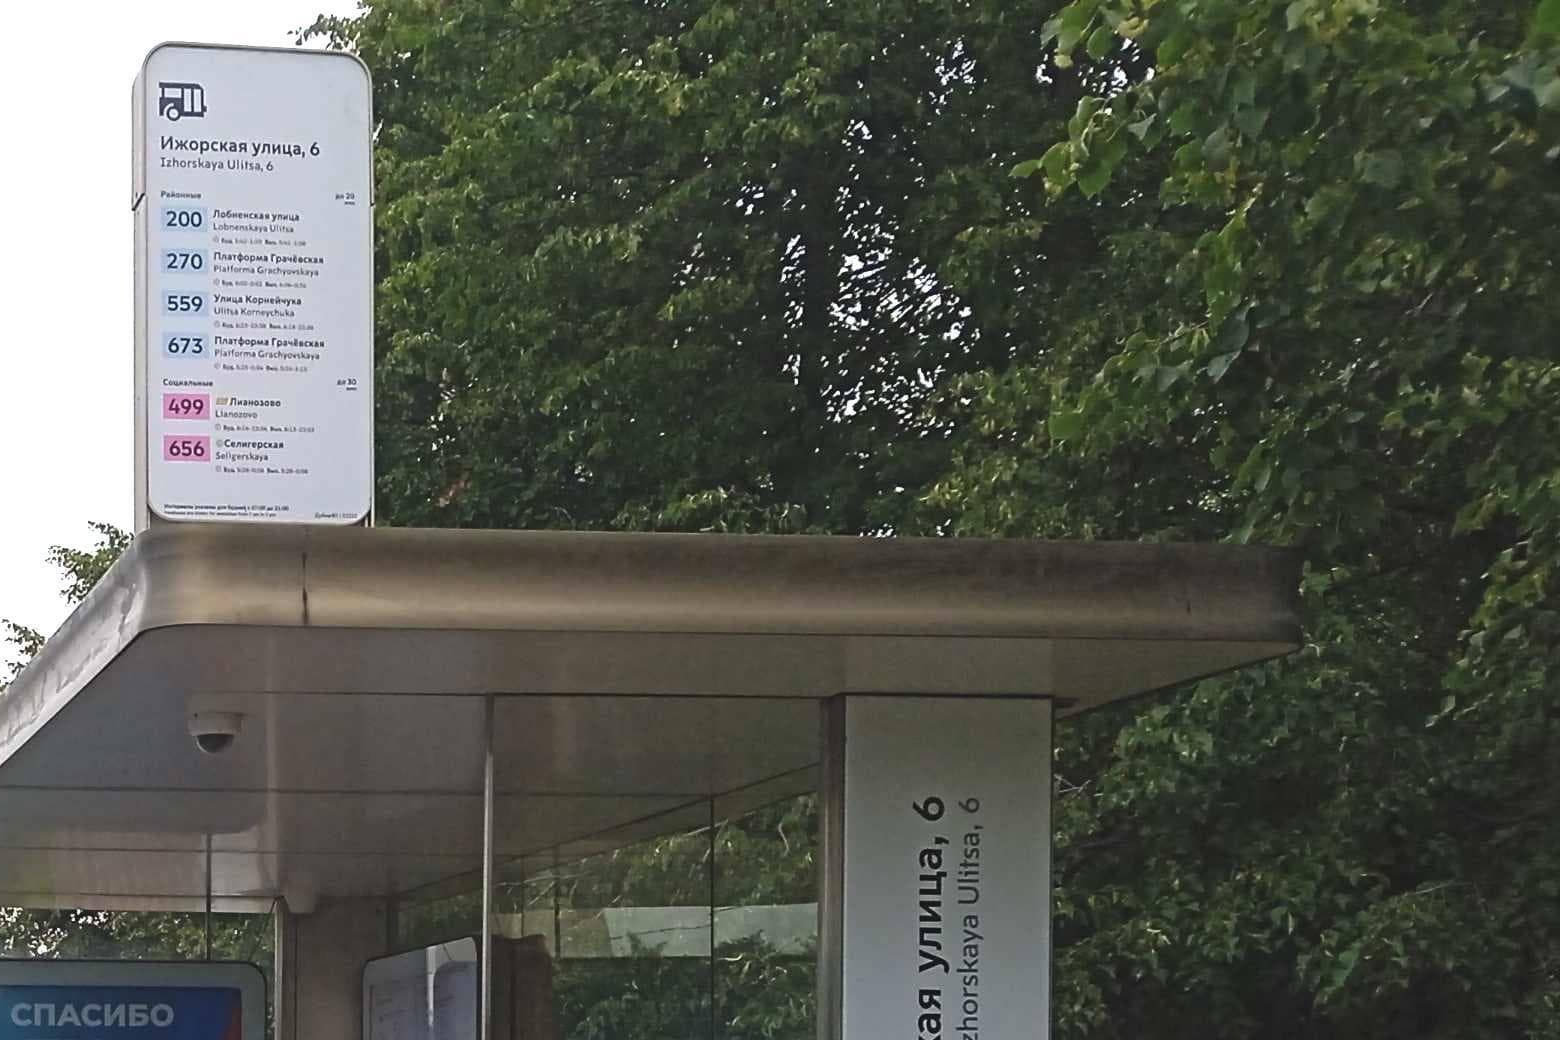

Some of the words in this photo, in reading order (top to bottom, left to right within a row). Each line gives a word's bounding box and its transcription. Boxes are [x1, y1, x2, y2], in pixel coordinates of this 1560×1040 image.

[160, 135, 248, 155] Ижорская
[252, 142, 306, 158] улица,
[309, 141, 320, 156] 6
[160, 156, 224, 171] Izhorskaya
[227, 159, 264, 172] Ulitsa,
[265, 160, 274, 171] 6
[166, 210, 203, 228] 200
[213, 209, 270, 220] Лобненская
[272, 213, 300, 222] улица
[213, 222, 268, 233] Lobnenskaya
[269, 224, 295, 233] Ulitsa
[167, 253, 203, 270] 270
[213, 252, 269, 263] Платформа
[271, 253, 324, 264] Грачёвская
[213, 265, 255, 275] Platforma
[257, 266, 319, 278] Grachyovskaya
[167, 295, 203, 313] 559
[213, 294, 243, 305] Улица
[245, 295, 302, 307] Корнейчука
[214, 307, 239, 316] Ulitsa
[167, 337, 203, 354] 673
[214, 336, 269, 347] Платформа
[271, 337, 325, 348] Грачёвская
[214, 348, 256, 358] Platforma
[258, 350, 320, 361] Grachyovskaya
[168, 398, 204, 416] 499
[230, 397, 281, 408] Лианозово
[215, 409, 258, 420] Lianozovo
[169, 440, 205, 457] 656
[224, 439, 284, 450] Селигерская
[215, 451, 269, 463] Seligerskaya
[912, 796, 946, 822] 6
[958, 797, 981, 813] 6
[957, 824, 984, 905] Ulitsa,
[918, 836, 950, 974] улица,
[10, 1002, 175, 1028] СПАСИБО
